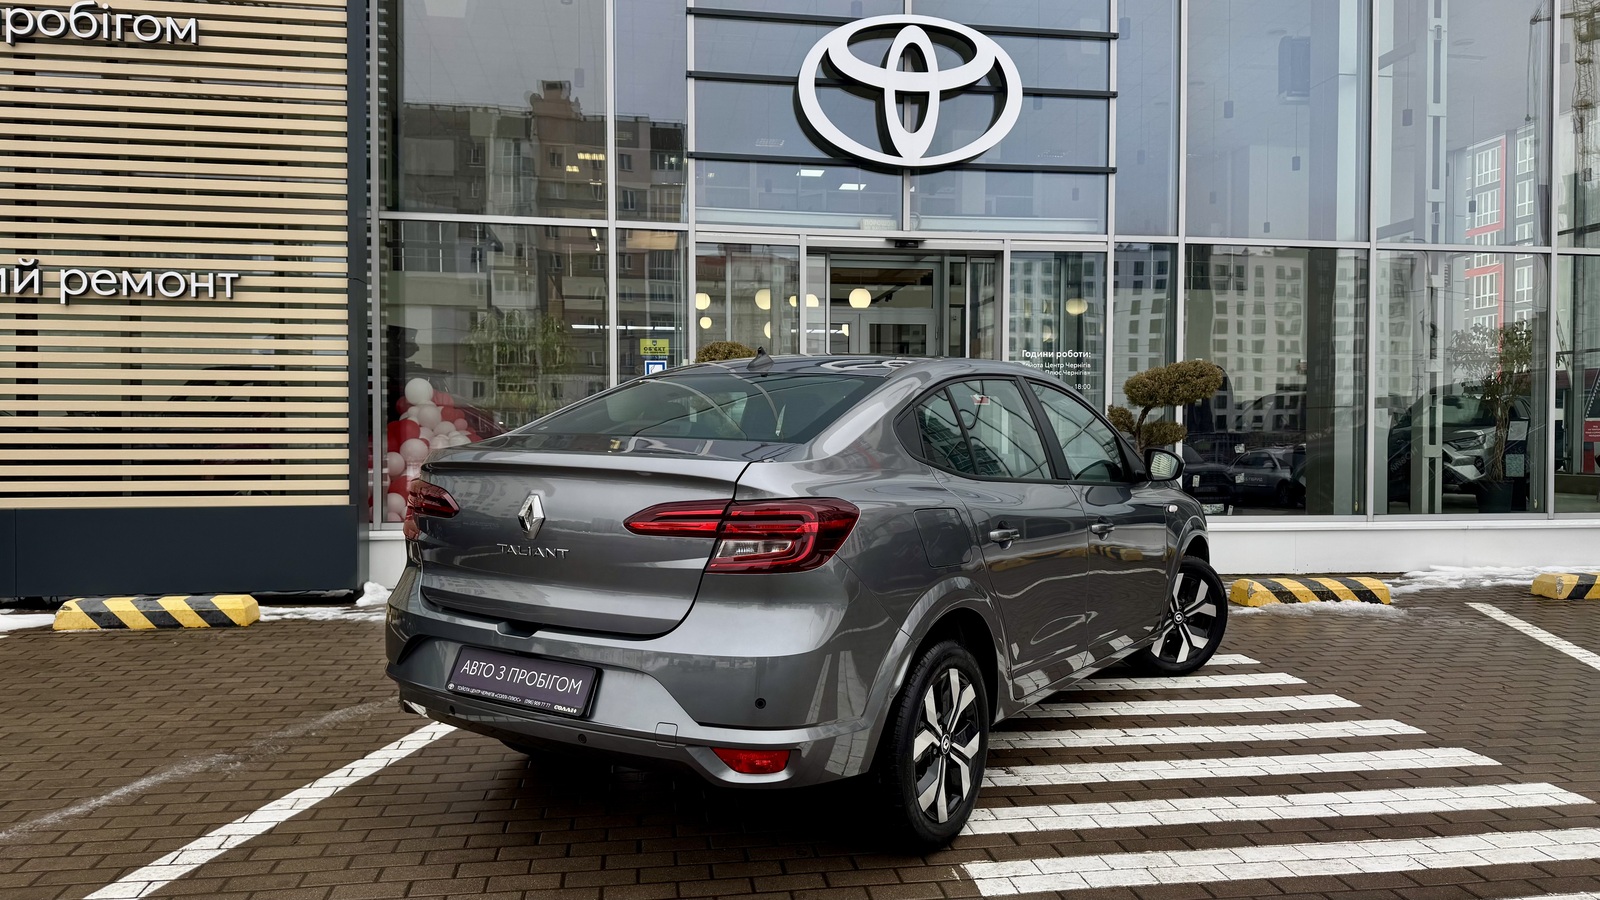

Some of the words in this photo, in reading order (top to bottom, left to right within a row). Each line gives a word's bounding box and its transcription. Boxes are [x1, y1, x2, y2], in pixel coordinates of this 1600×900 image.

[0, 0, 199, 45] робігом
[60, 268, 240, 304] ремонт
[1021, 349, 1054, 359] Години
[1056, 349, 1091, 360] роботи:
[496, 543, 570, 559] TALIANT
[460, 659, 495, 678] АВТО
[506, 667, 583, 695] ПРОБІГОМ
